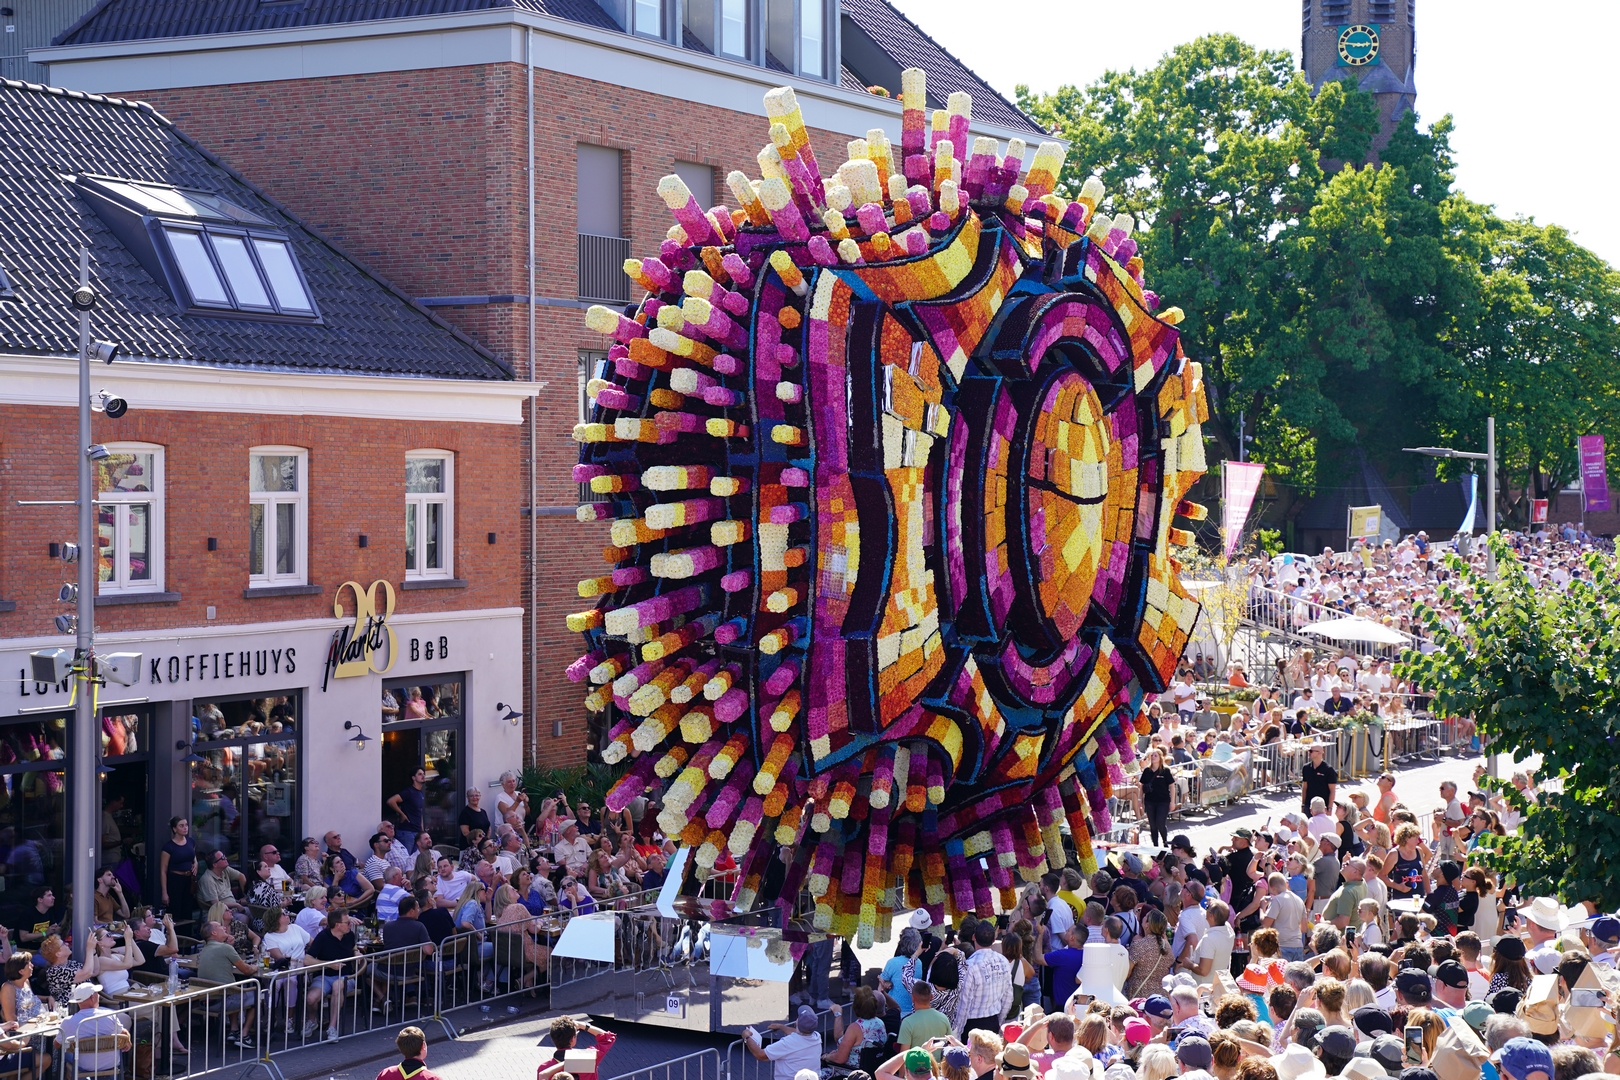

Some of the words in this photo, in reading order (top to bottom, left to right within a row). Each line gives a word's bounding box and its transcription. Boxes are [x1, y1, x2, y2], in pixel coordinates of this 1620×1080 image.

[333, 579, 398, 678] 28
[150, 647, 296, 685] KOFFIEHUYS
[321, 616, 385, 692] Markt
[409, 635, 449, 662] B&B
[668, 999, 678, 1008] 09
